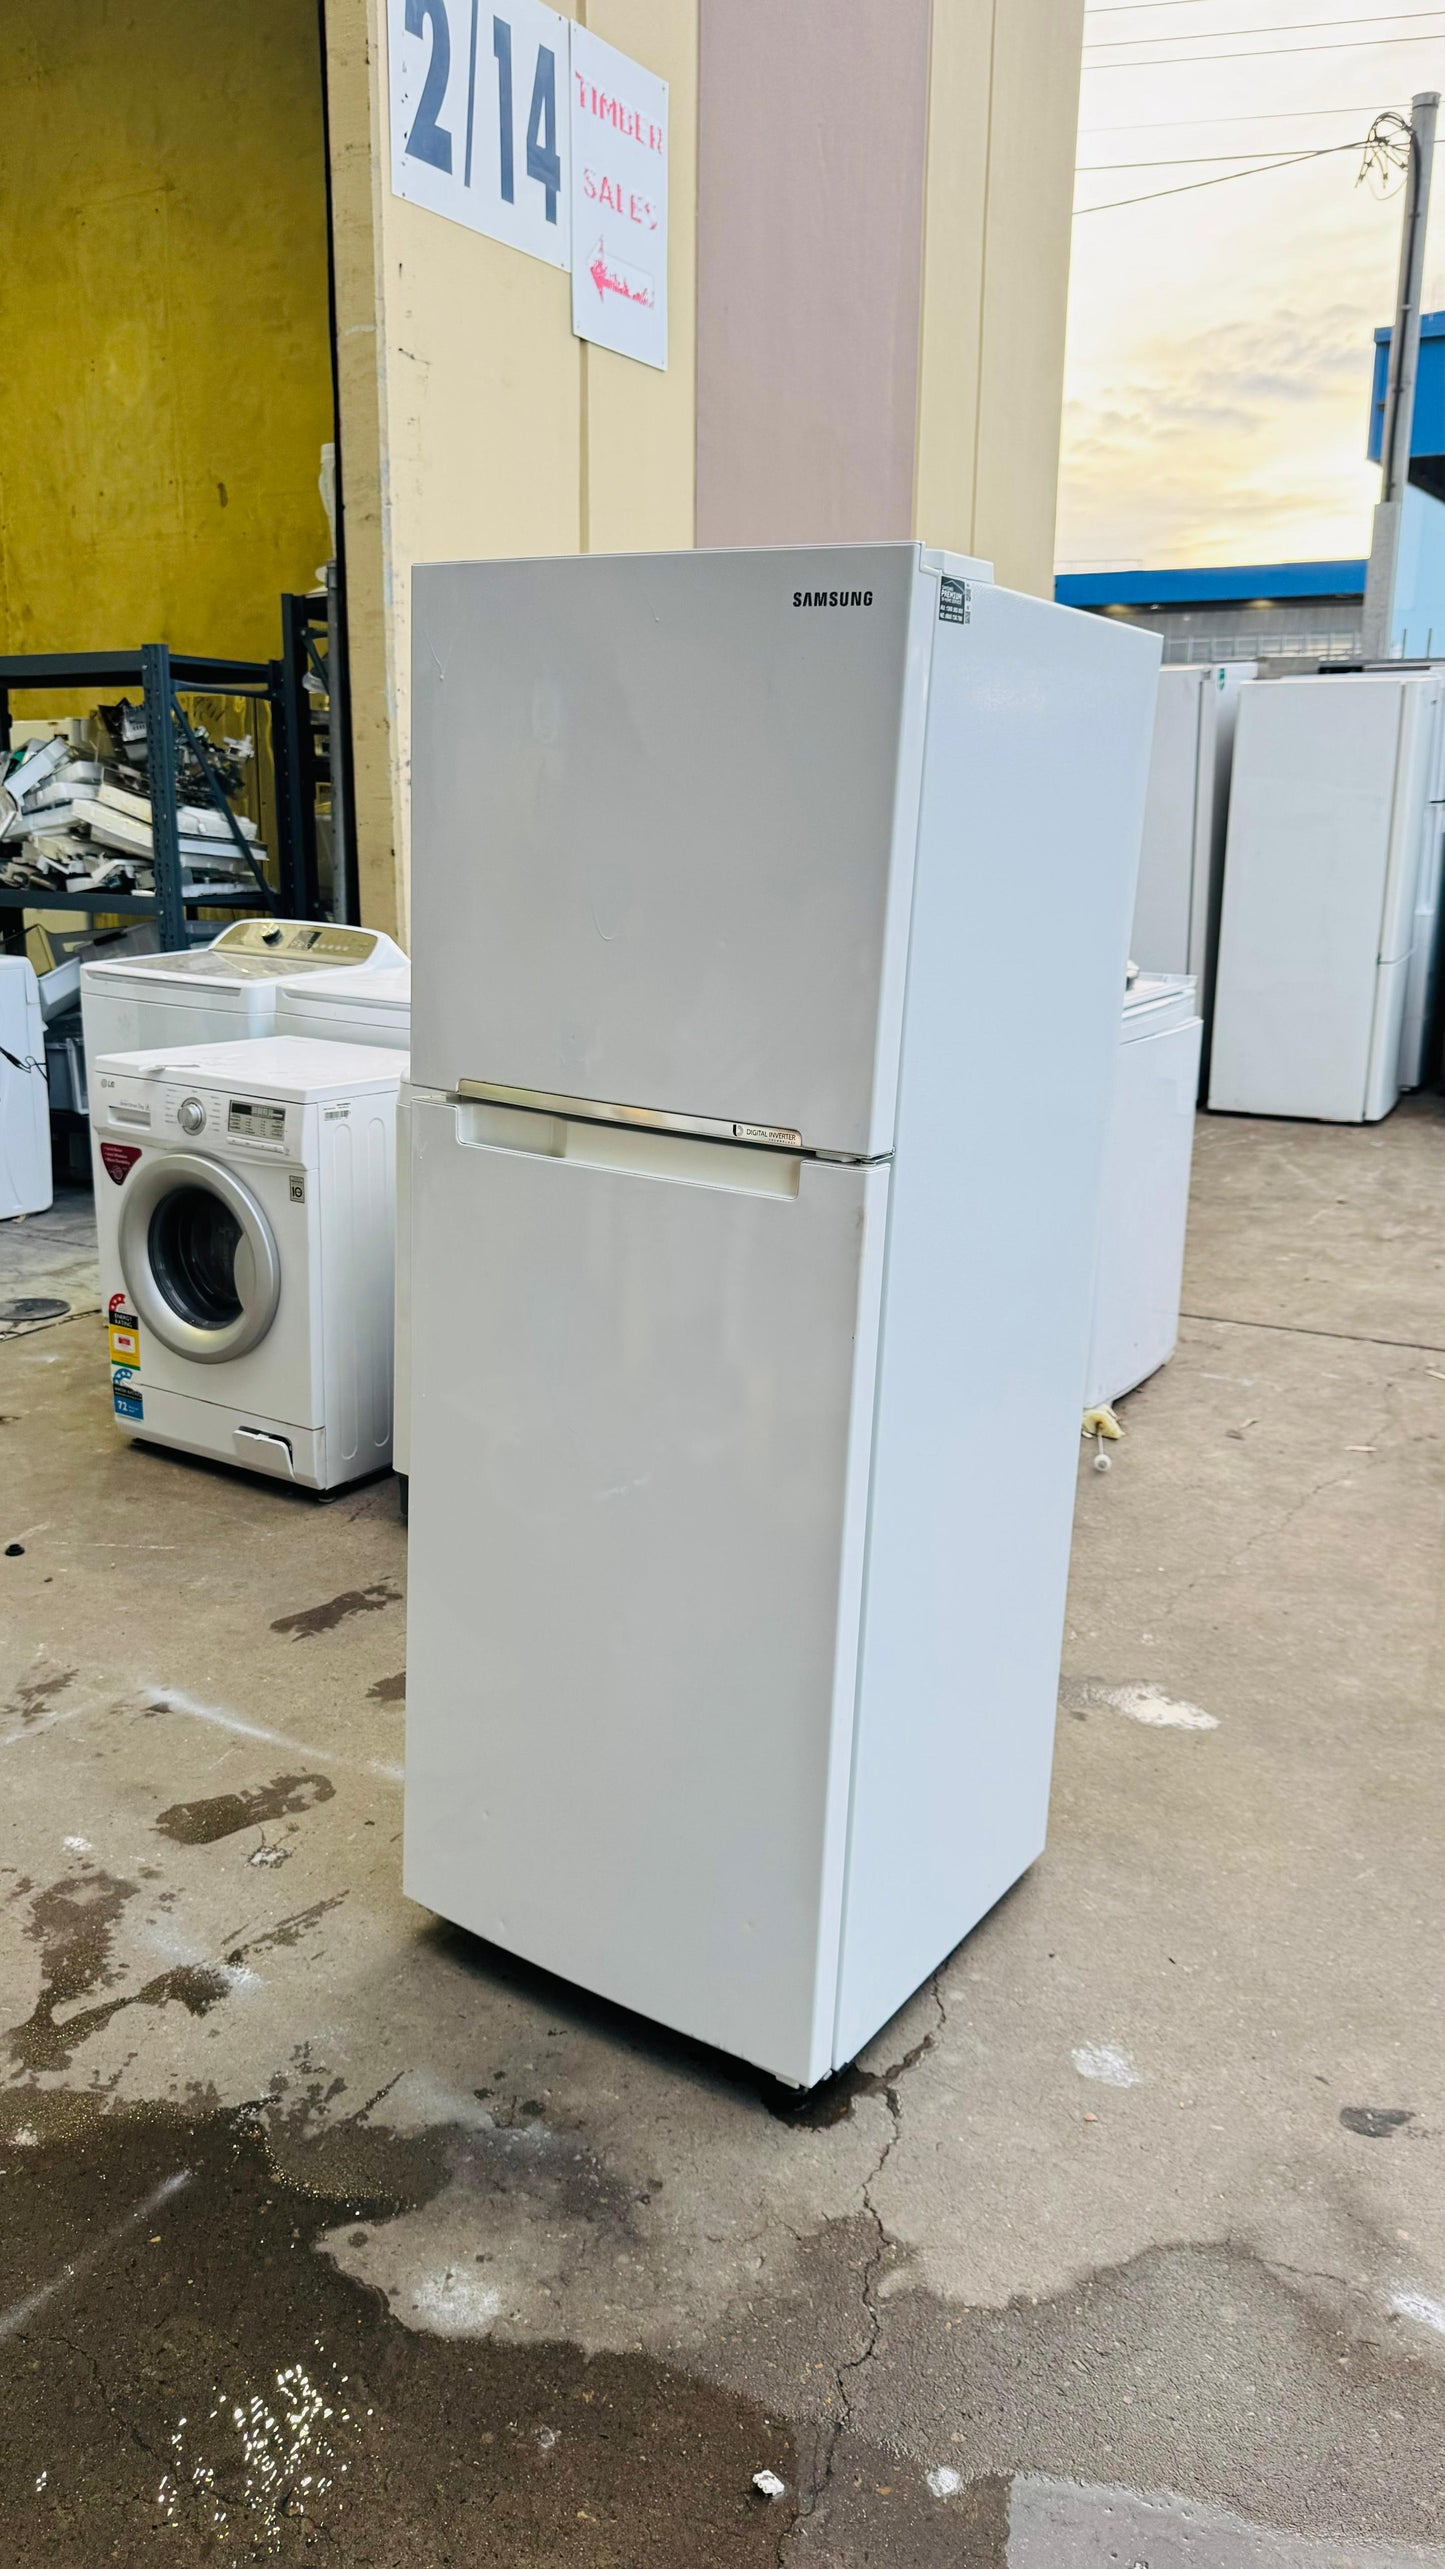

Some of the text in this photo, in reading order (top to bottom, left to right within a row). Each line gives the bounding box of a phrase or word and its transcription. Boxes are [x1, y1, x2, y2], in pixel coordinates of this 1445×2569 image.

[404, 0, 561, 226] 2/14
[583, 167, 658, 231] SALES
[792, 590, 873, 607] SAMSUNG
[746, 1128, 768, 1138] DIGITAL
[768, 1131, 796, 1141] INVERTER
